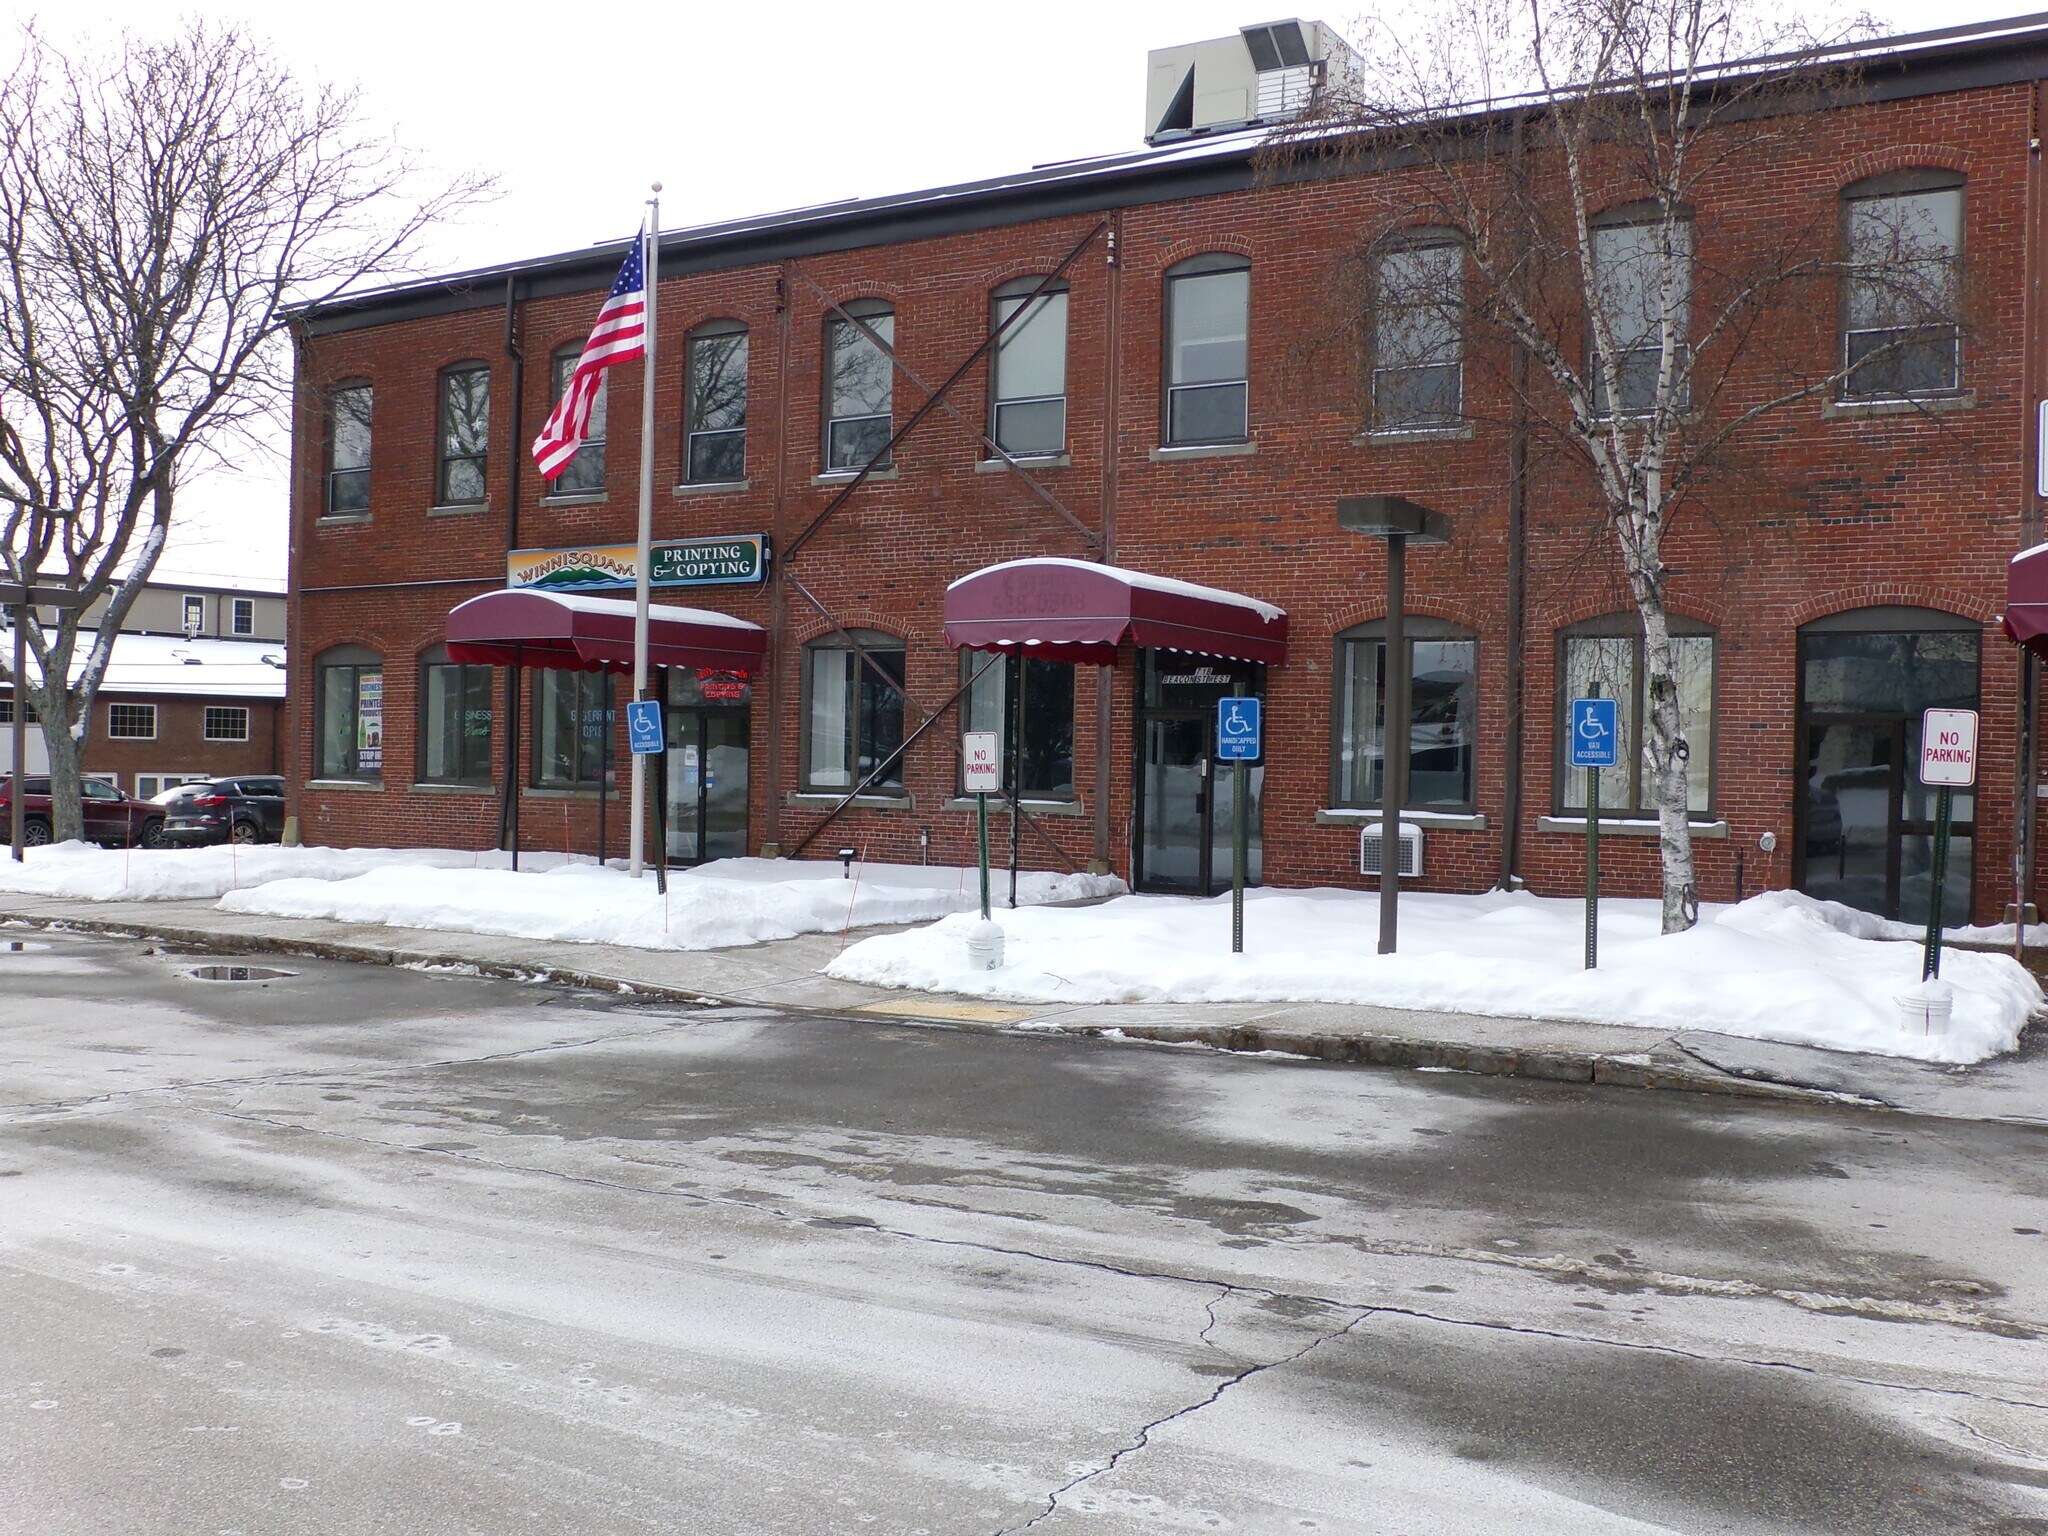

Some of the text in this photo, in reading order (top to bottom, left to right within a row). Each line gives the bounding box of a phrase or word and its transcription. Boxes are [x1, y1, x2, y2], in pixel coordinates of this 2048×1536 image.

[663, 545, 742, 563] PRINTING
[516, 550, 636, 583] WINNISQUAM
[652, 560, 751, 578] & COPYING
[1162, 675, 1231, 684] BEACON ST WEST
[700, 683, 736, 691] PRINTING
[1940, 731, 1959, 746] NO
[1231, 745, 1247, 753] ONLY
[1587, 741, 1600, 749] VAN
[359, 751, 374, 760] STOP
[974, 749, 987, 761] NO
[1576, 750, 1611, 759] ACCESSIBLE
[1925, 748, 1971, 764] PARKING
[966, 763, 995, 775] PARKING
